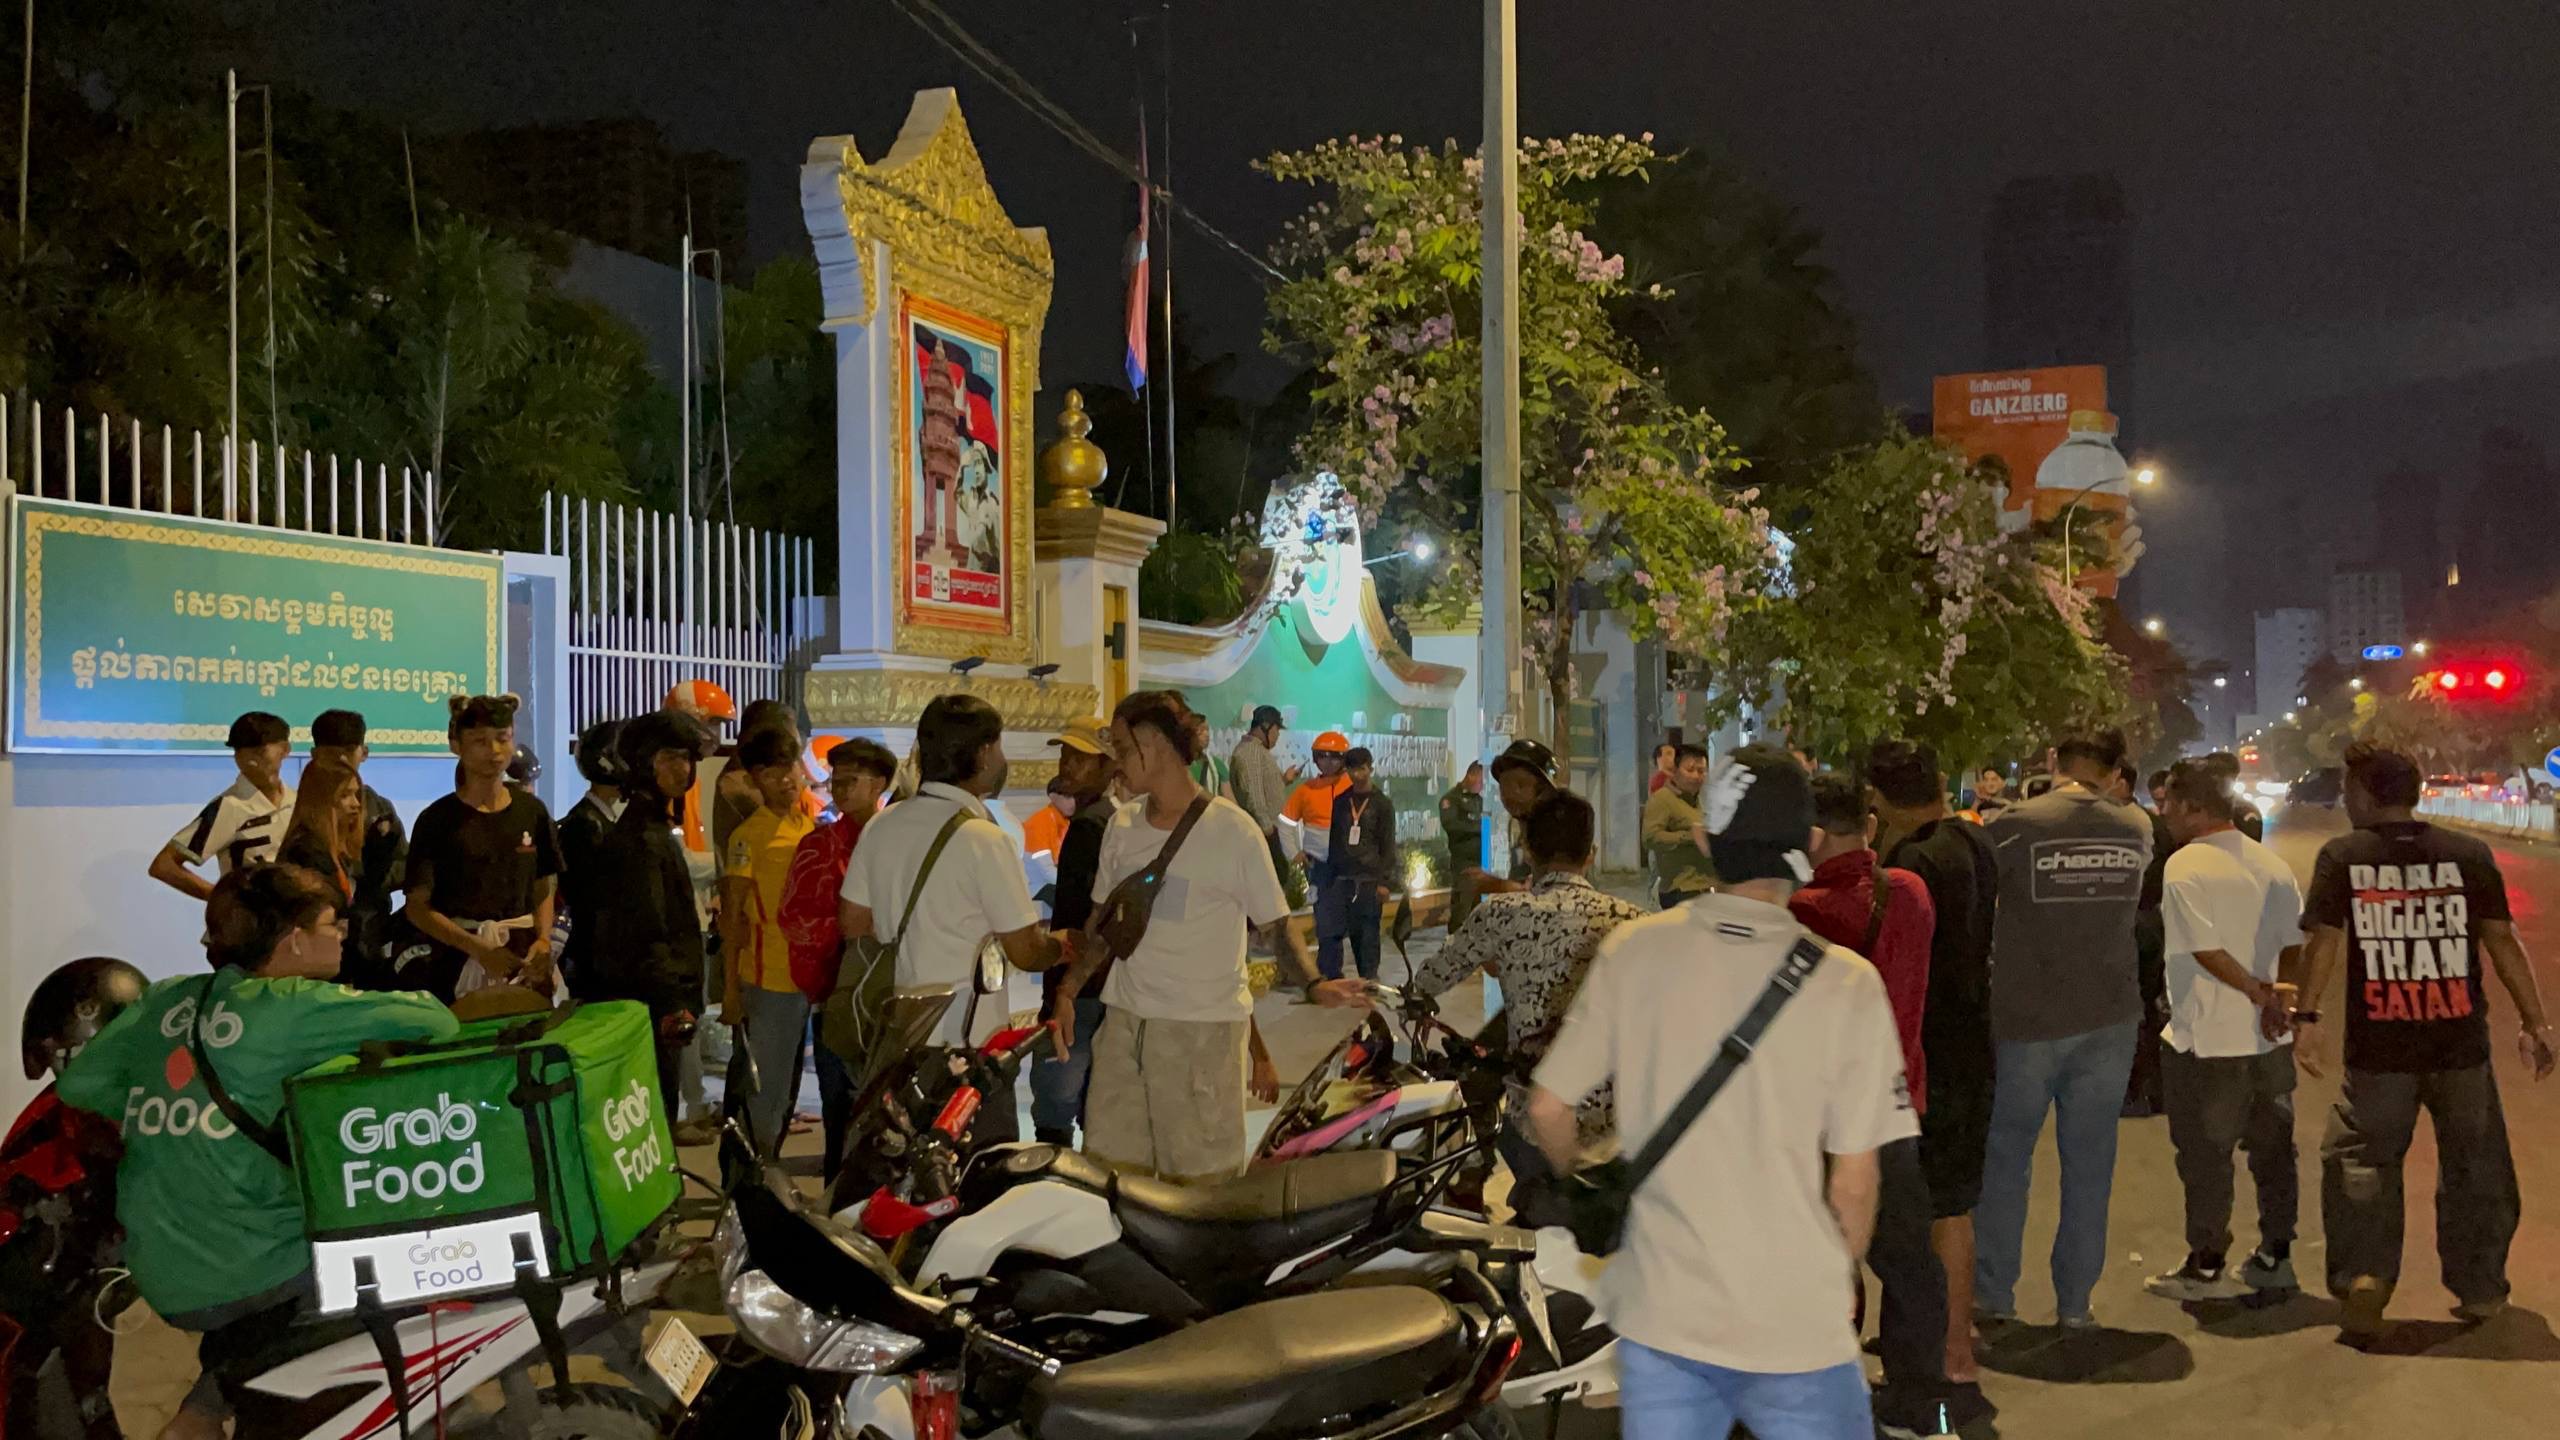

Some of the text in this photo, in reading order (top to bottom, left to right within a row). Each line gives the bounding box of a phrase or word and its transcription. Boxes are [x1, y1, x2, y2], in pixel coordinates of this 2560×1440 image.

[1970, 392, 2068, 416] GANZBERG
[2350, 862, 2464, 891] DARA
[2352, 894, 2469, 939] BIGGER
[2359, 937, 2469, 981] THAN
[2363, 978, 2473, 1021] SATAN
[340, 1091, 477, 1154] Grab
[343, 1141, 485, 1208] Food
[614, 1120, 661, 1193] Food
[408, 1238, 478, 1265] Grab
[413, 1259, 483, 1290] Food
